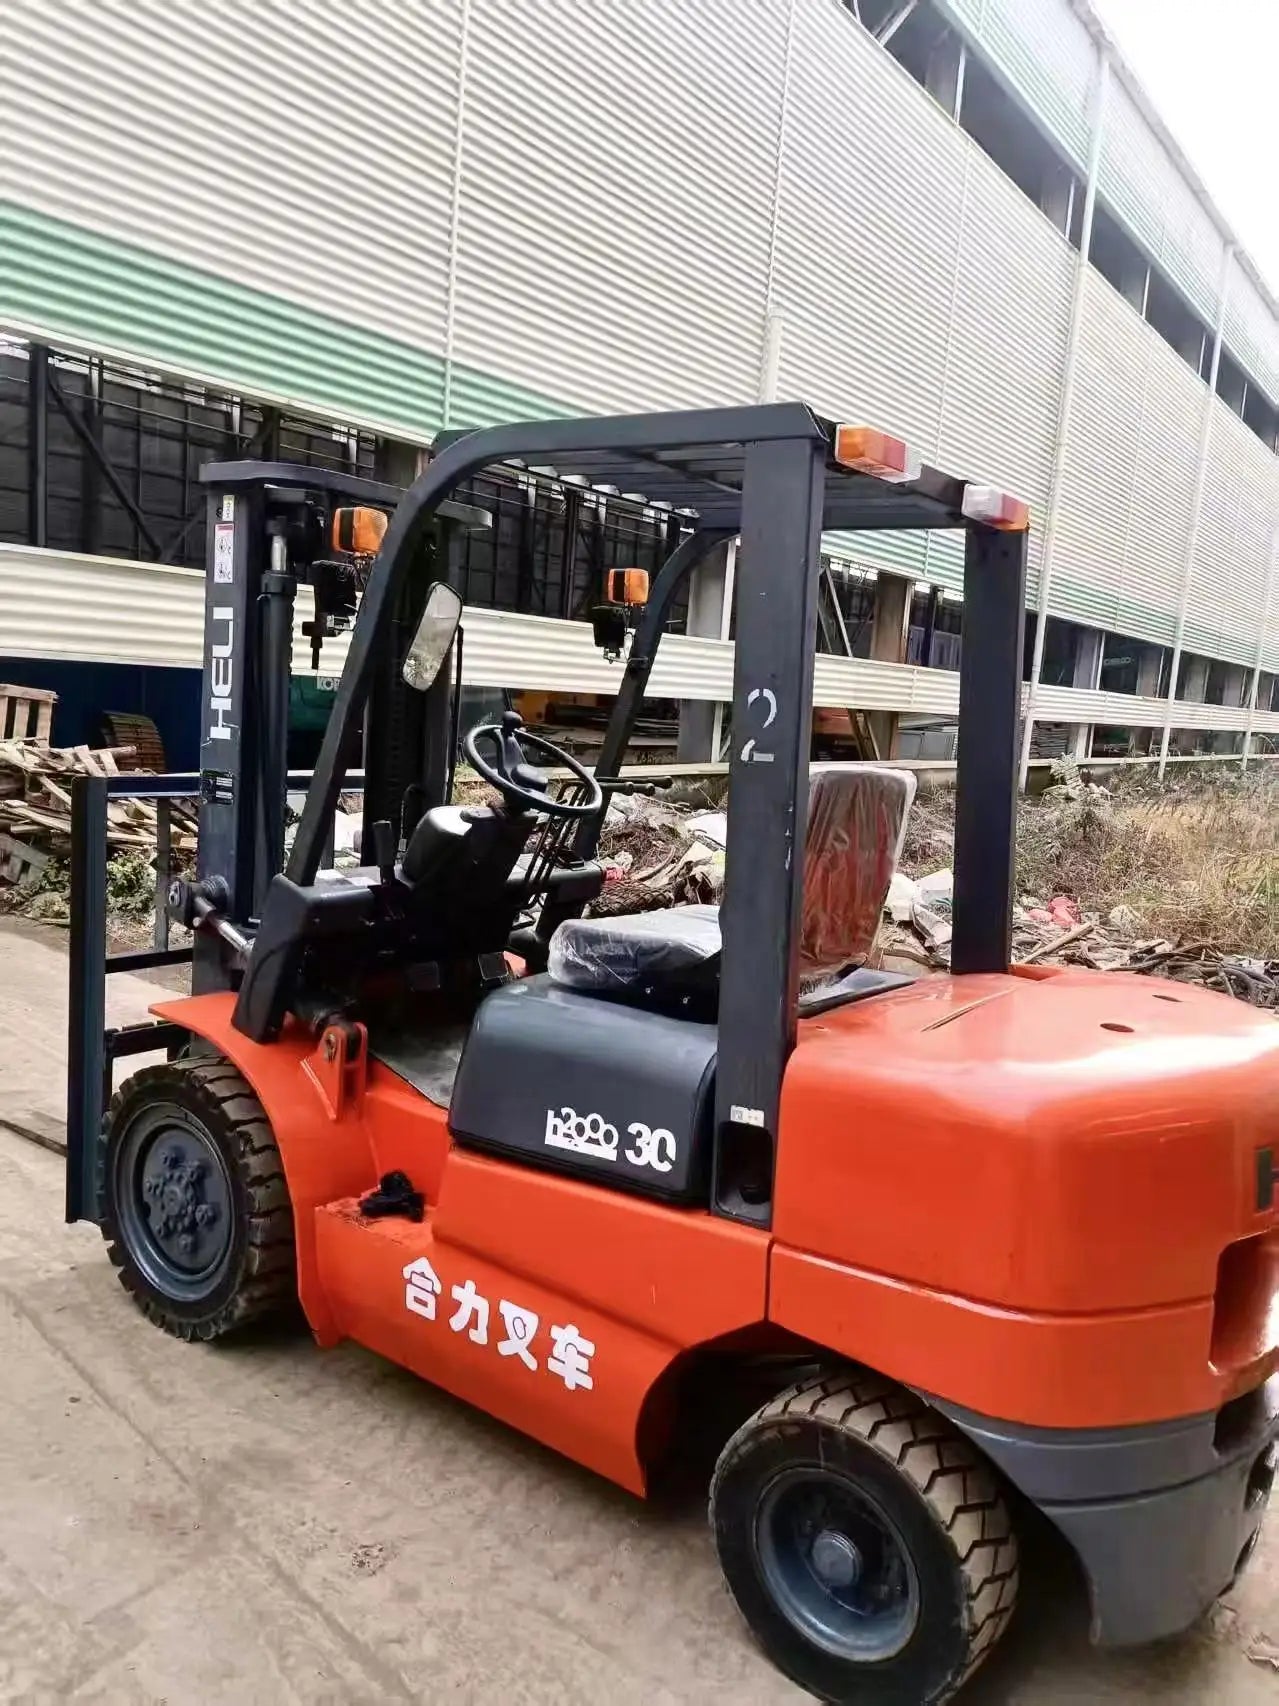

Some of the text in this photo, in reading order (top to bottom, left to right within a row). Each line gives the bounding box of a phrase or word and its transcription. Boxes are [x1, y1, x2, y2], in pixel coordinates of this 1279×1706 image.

[210, 607, 234, 740] HELI
[740, 688, 777, 762] 2
[625, 1122, 677, 1172] 30
[402, 1256, 595, 1390] 合力叉车
